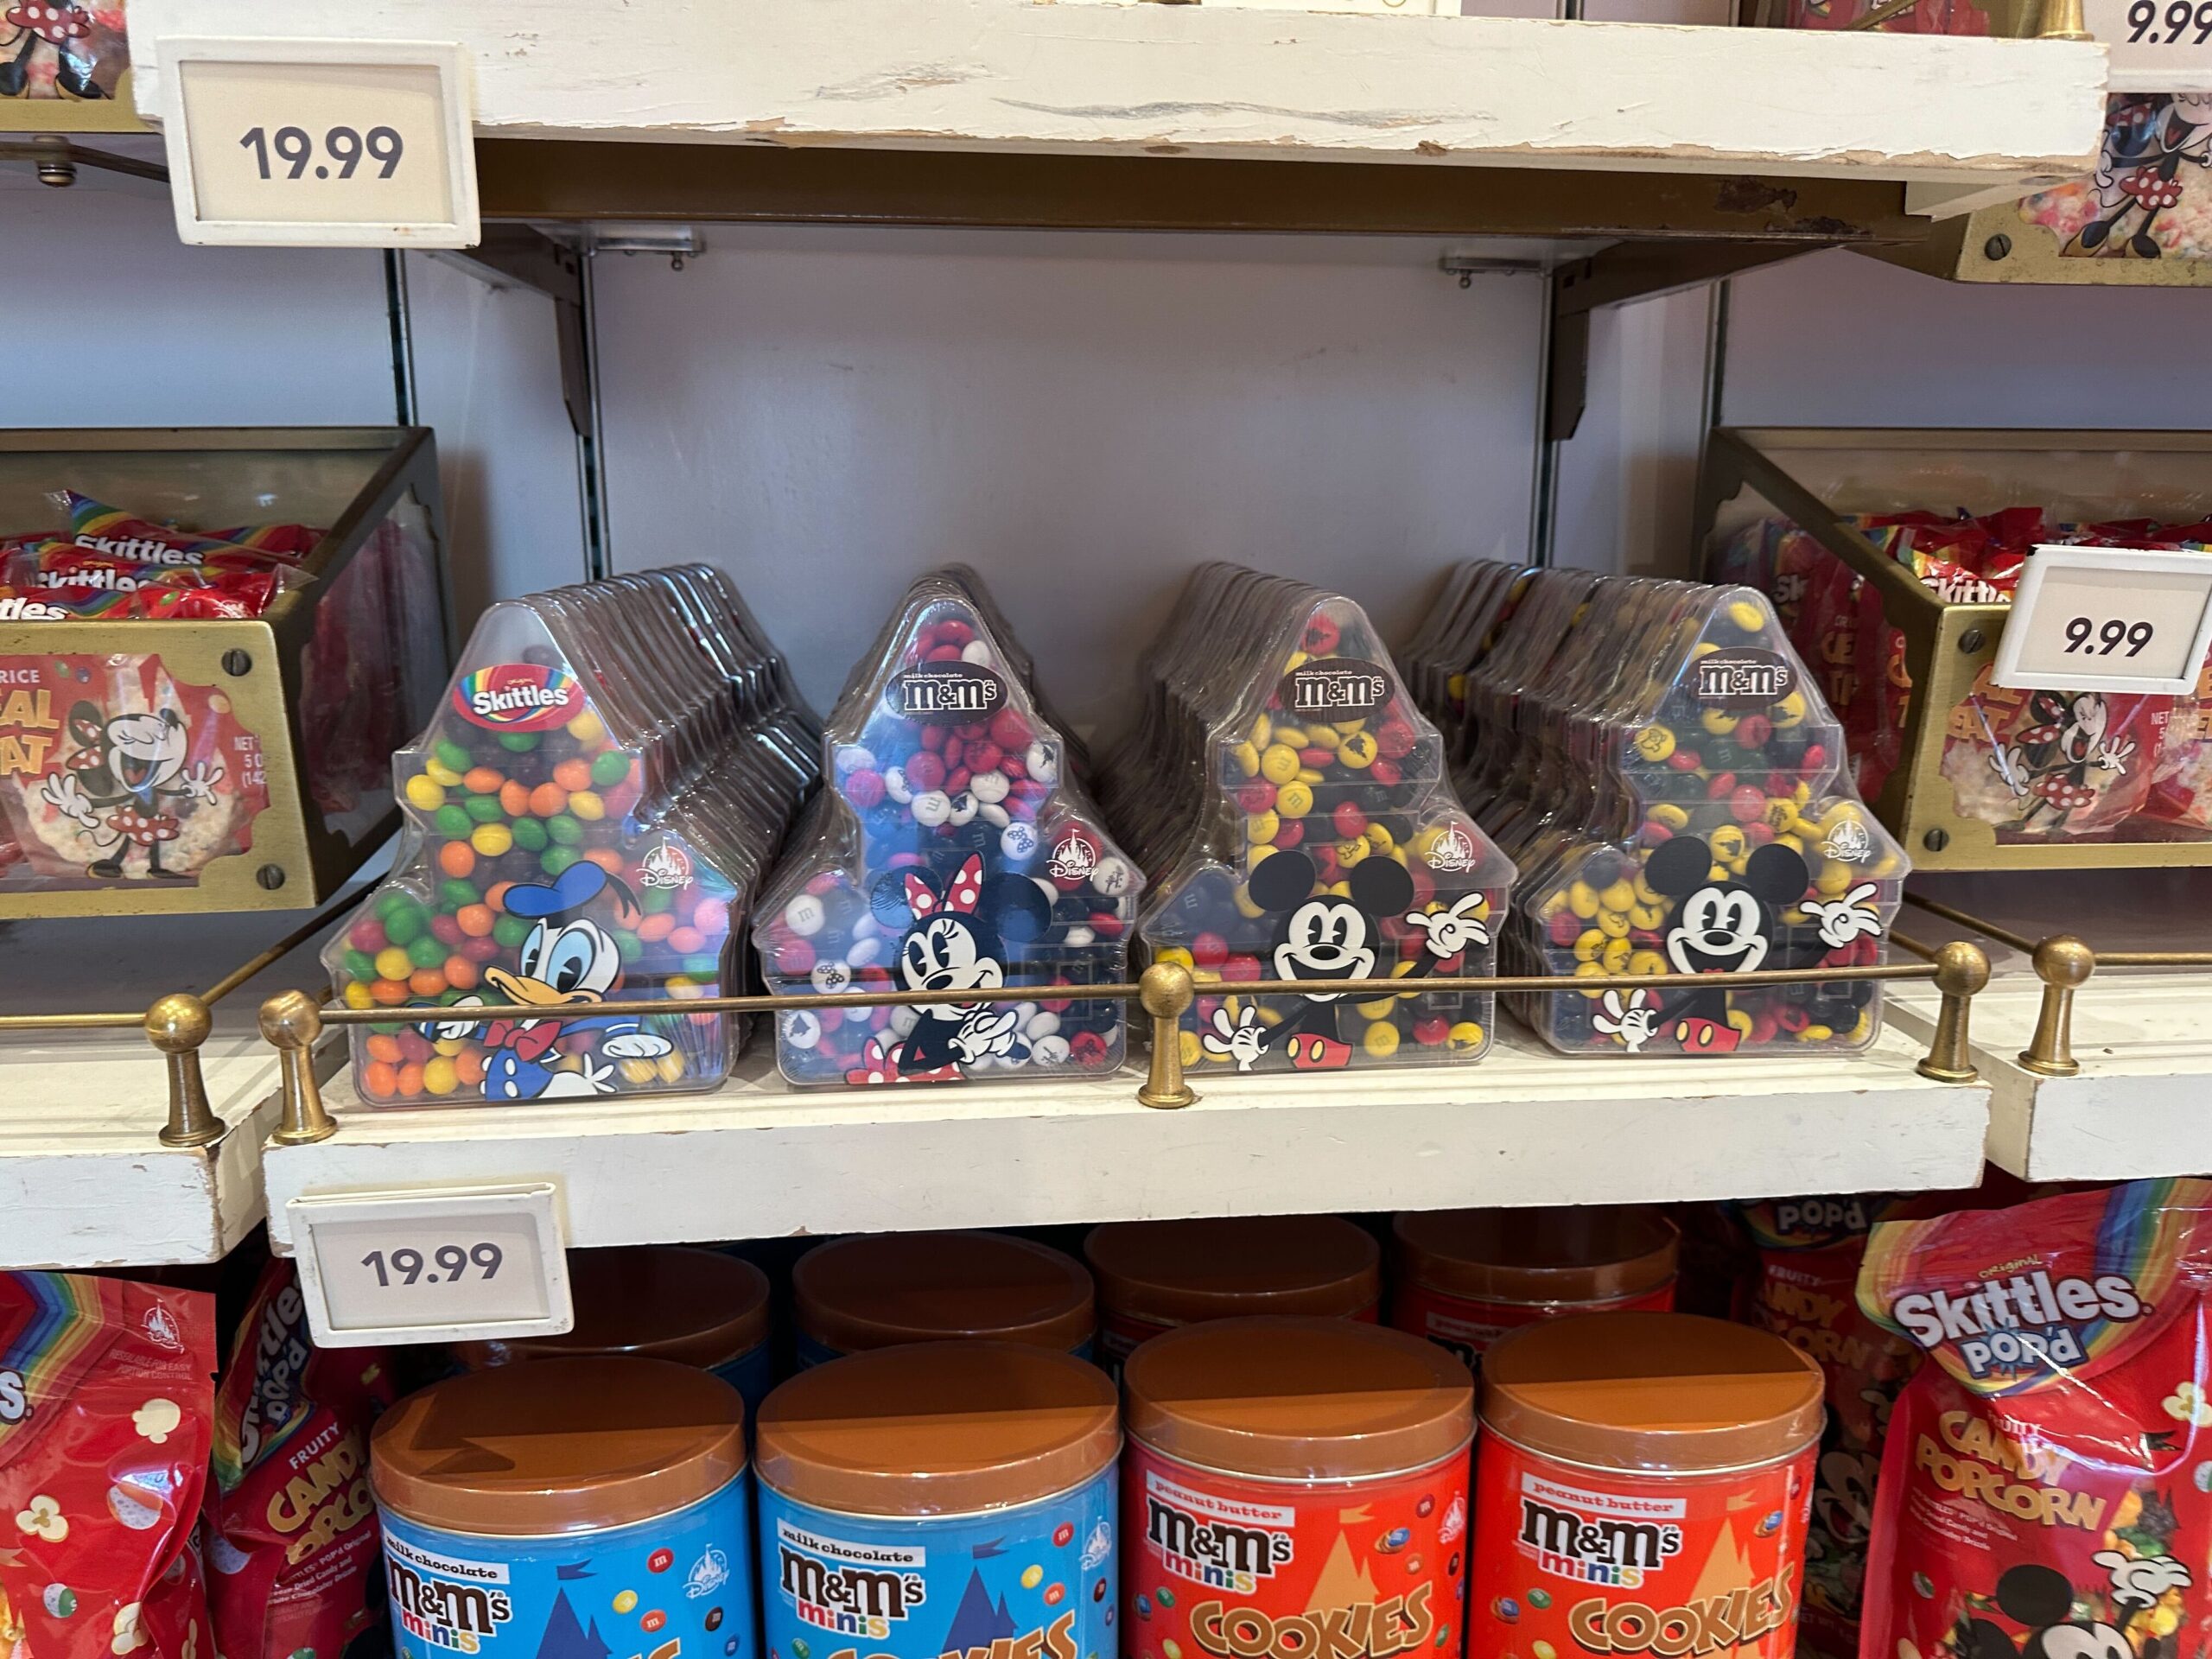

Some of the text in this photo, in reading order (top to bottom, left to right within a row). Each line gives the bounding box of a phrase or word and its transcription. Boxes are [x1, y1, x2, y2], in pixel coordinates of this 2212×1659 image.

[2126, 0, 2212, 45] 9.99
[239, 126, 404, 180] 19.99
[74, 534, 205, 565] Skittles
[2063, 617, 2153, 658] 9.99
[472, 684, 569, 715] Skittles
[360, 1242, 503, 1287] 19.99
[1894, 1270, 2141, 1348] Skittles
[1961, 1326, 2082, 1373] POP'd
[289, 1421, 340, 1470] FRUITY
[1939, 1410, 2071, 1487] CANDY
[1155, 1481, 1282, 1519] peanut butter
[1533, 1482, 1674, 1512] peanut butter
[1915, 1433, 2107, 1531] POPCORN
[286, 1478, 374, 1566] OPCO
[386, 1535, 499, 1580] milk chocolate
[782, 1528, 914, 1563] milk chocolate
[1165, 1551, 1255, 1592] minis
[1541, 1551, 1643, 1588] minis
[403, 1609, 480, 1652] minis
[798, 1599, 889, 1638] minis
[1190, 1580, 1433, 1659] COOKIES
[1567, 1561, 1795, 1656] COOKIES
